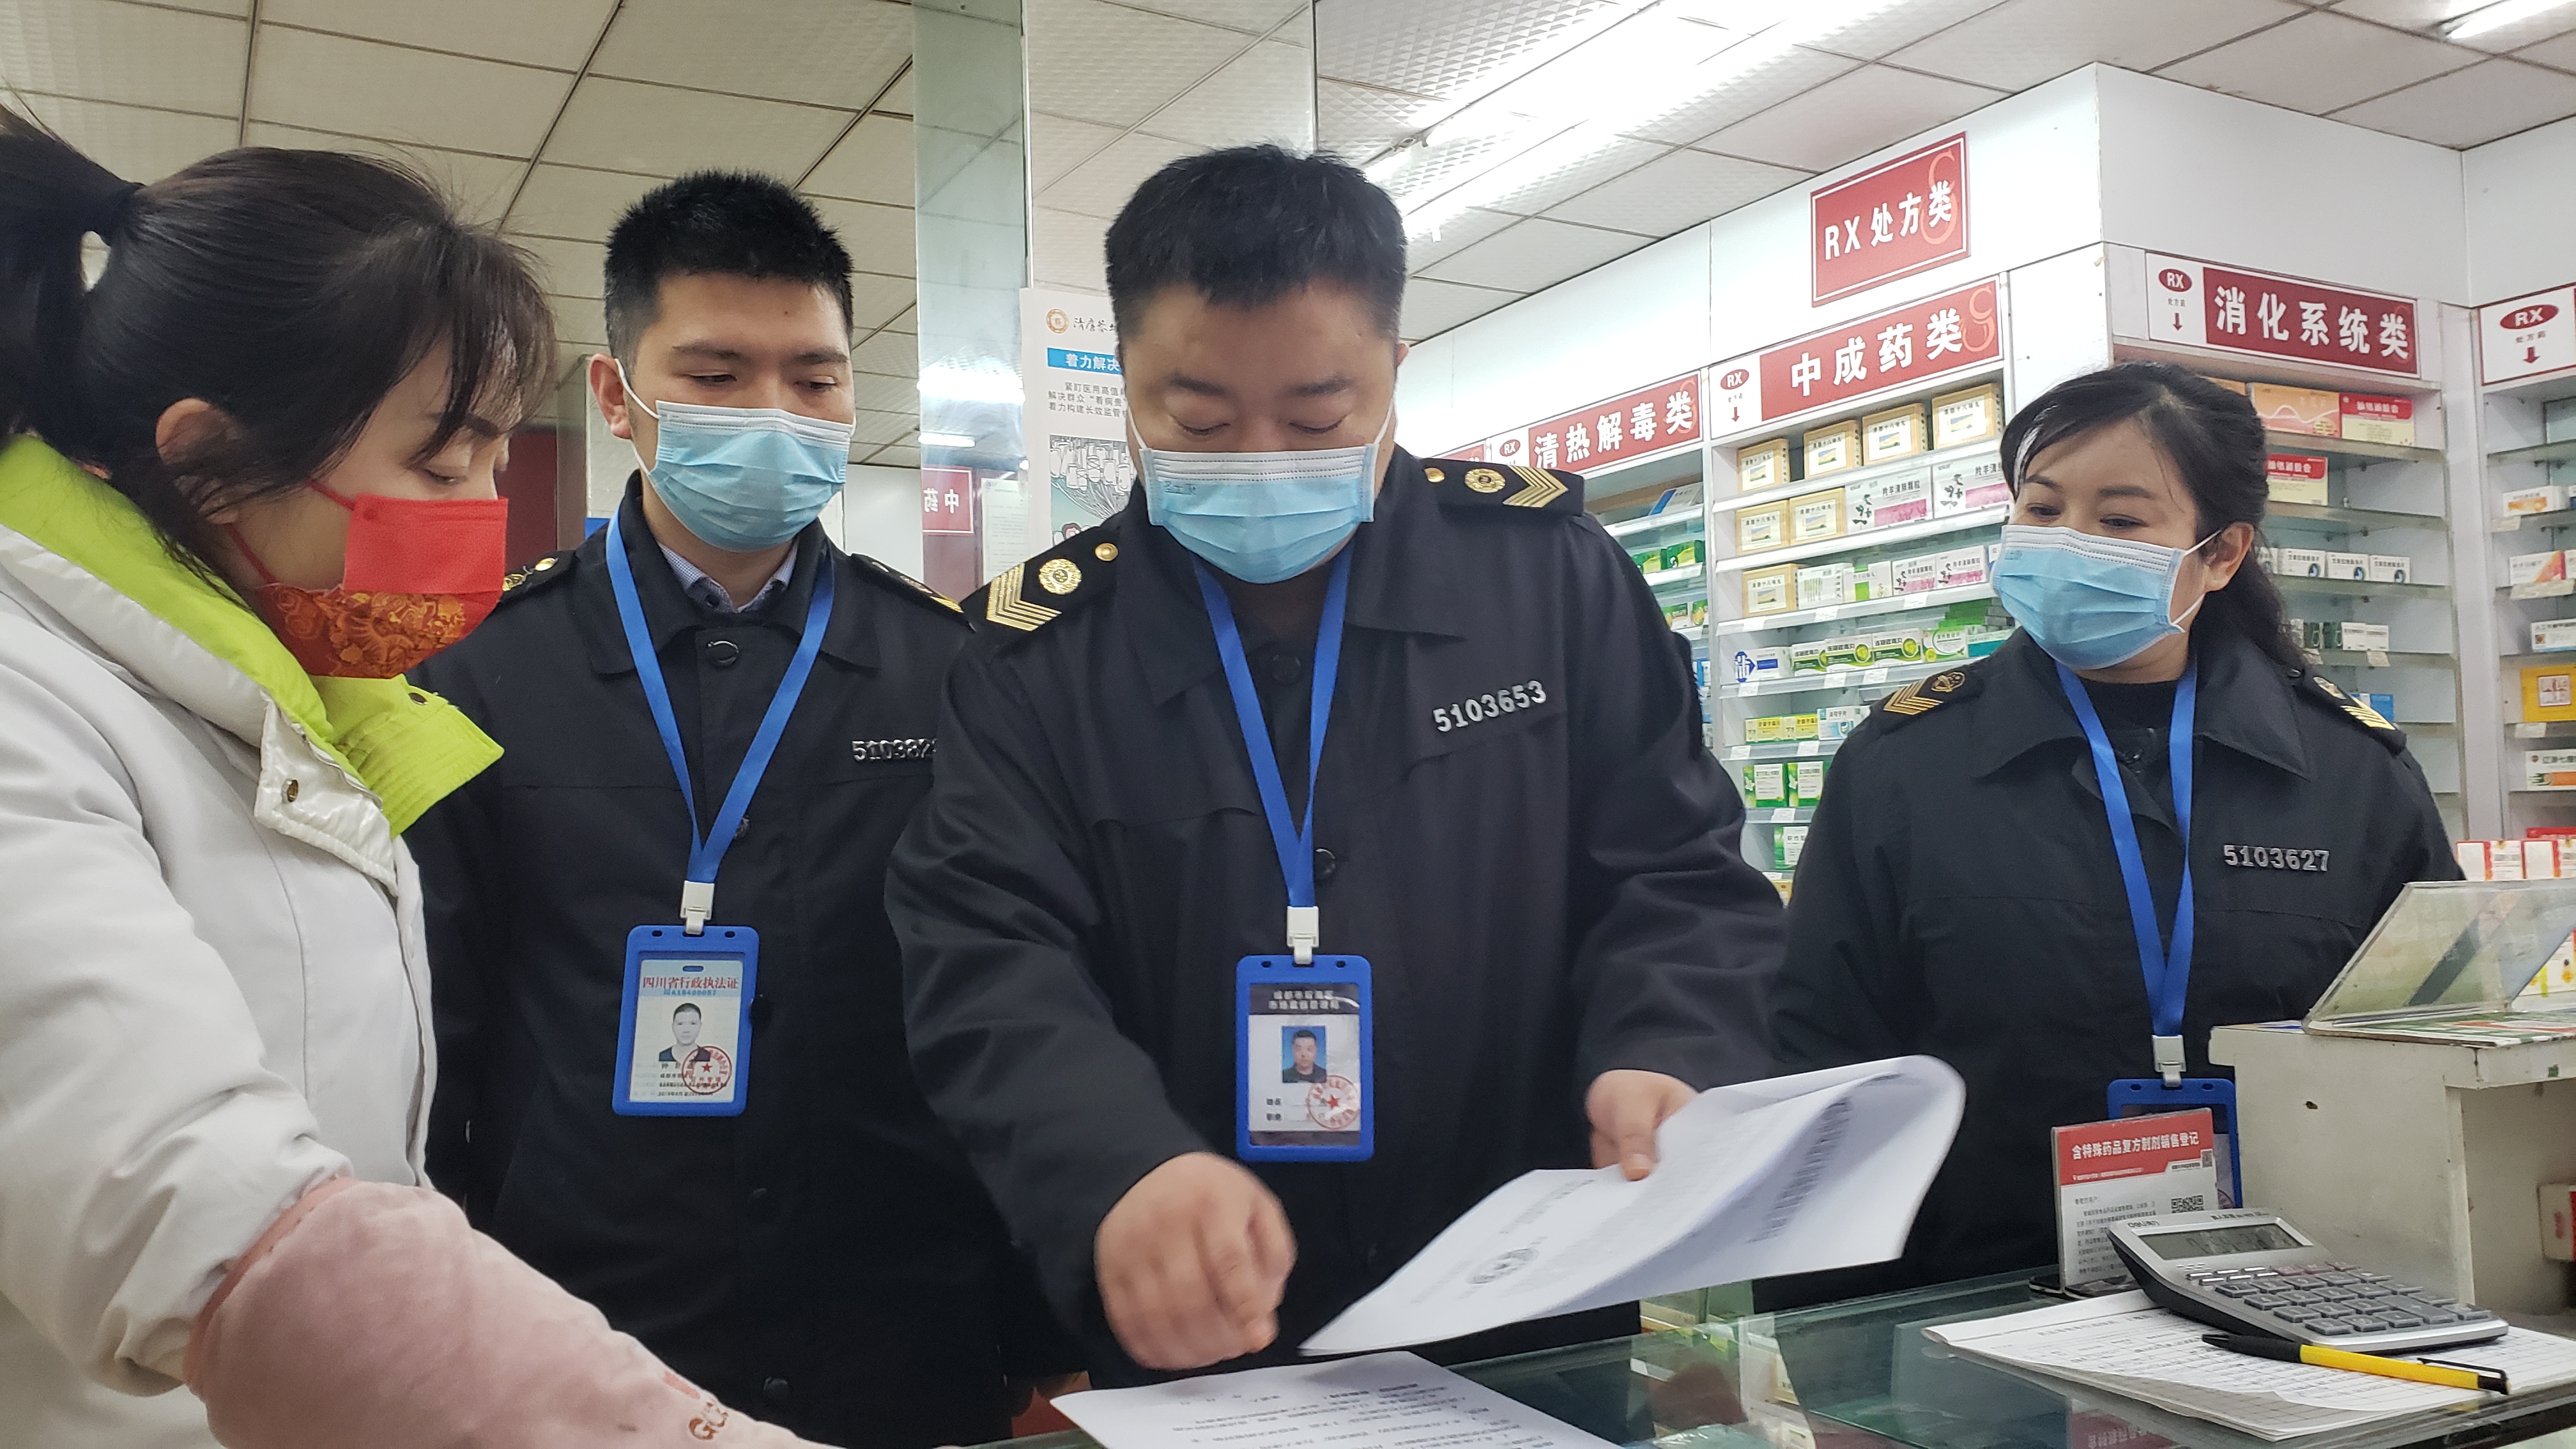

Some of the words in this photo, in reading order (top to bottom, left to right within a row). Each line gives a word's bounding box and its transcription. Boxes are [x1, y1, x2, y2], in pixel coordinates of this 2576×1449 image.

[1825, 216, 1861, 260] RX
[1871, 180, 1952, 243] 处方类
[2166, 272, 2184, 289] RX
[2214, 286, 2409, 359] 消化系统类
[2515, 307, 2543, 326] RX
[1066, 353, 1119, 371] 着力解决
[1791, 308, 1963, 397] 中成药类
[1727, 372, 1743, 387] RX
[1535, 391, 1693, 469] 清热解毒类
[1432, 680, 1546, 732] 5103653
[2223, 845, 2329, 871] 5103627
[643, 977, 739, 989] 四川省行政执法证
[2072, 1131, 2200, 1160] 含特殊药品复方制剂销售登记
